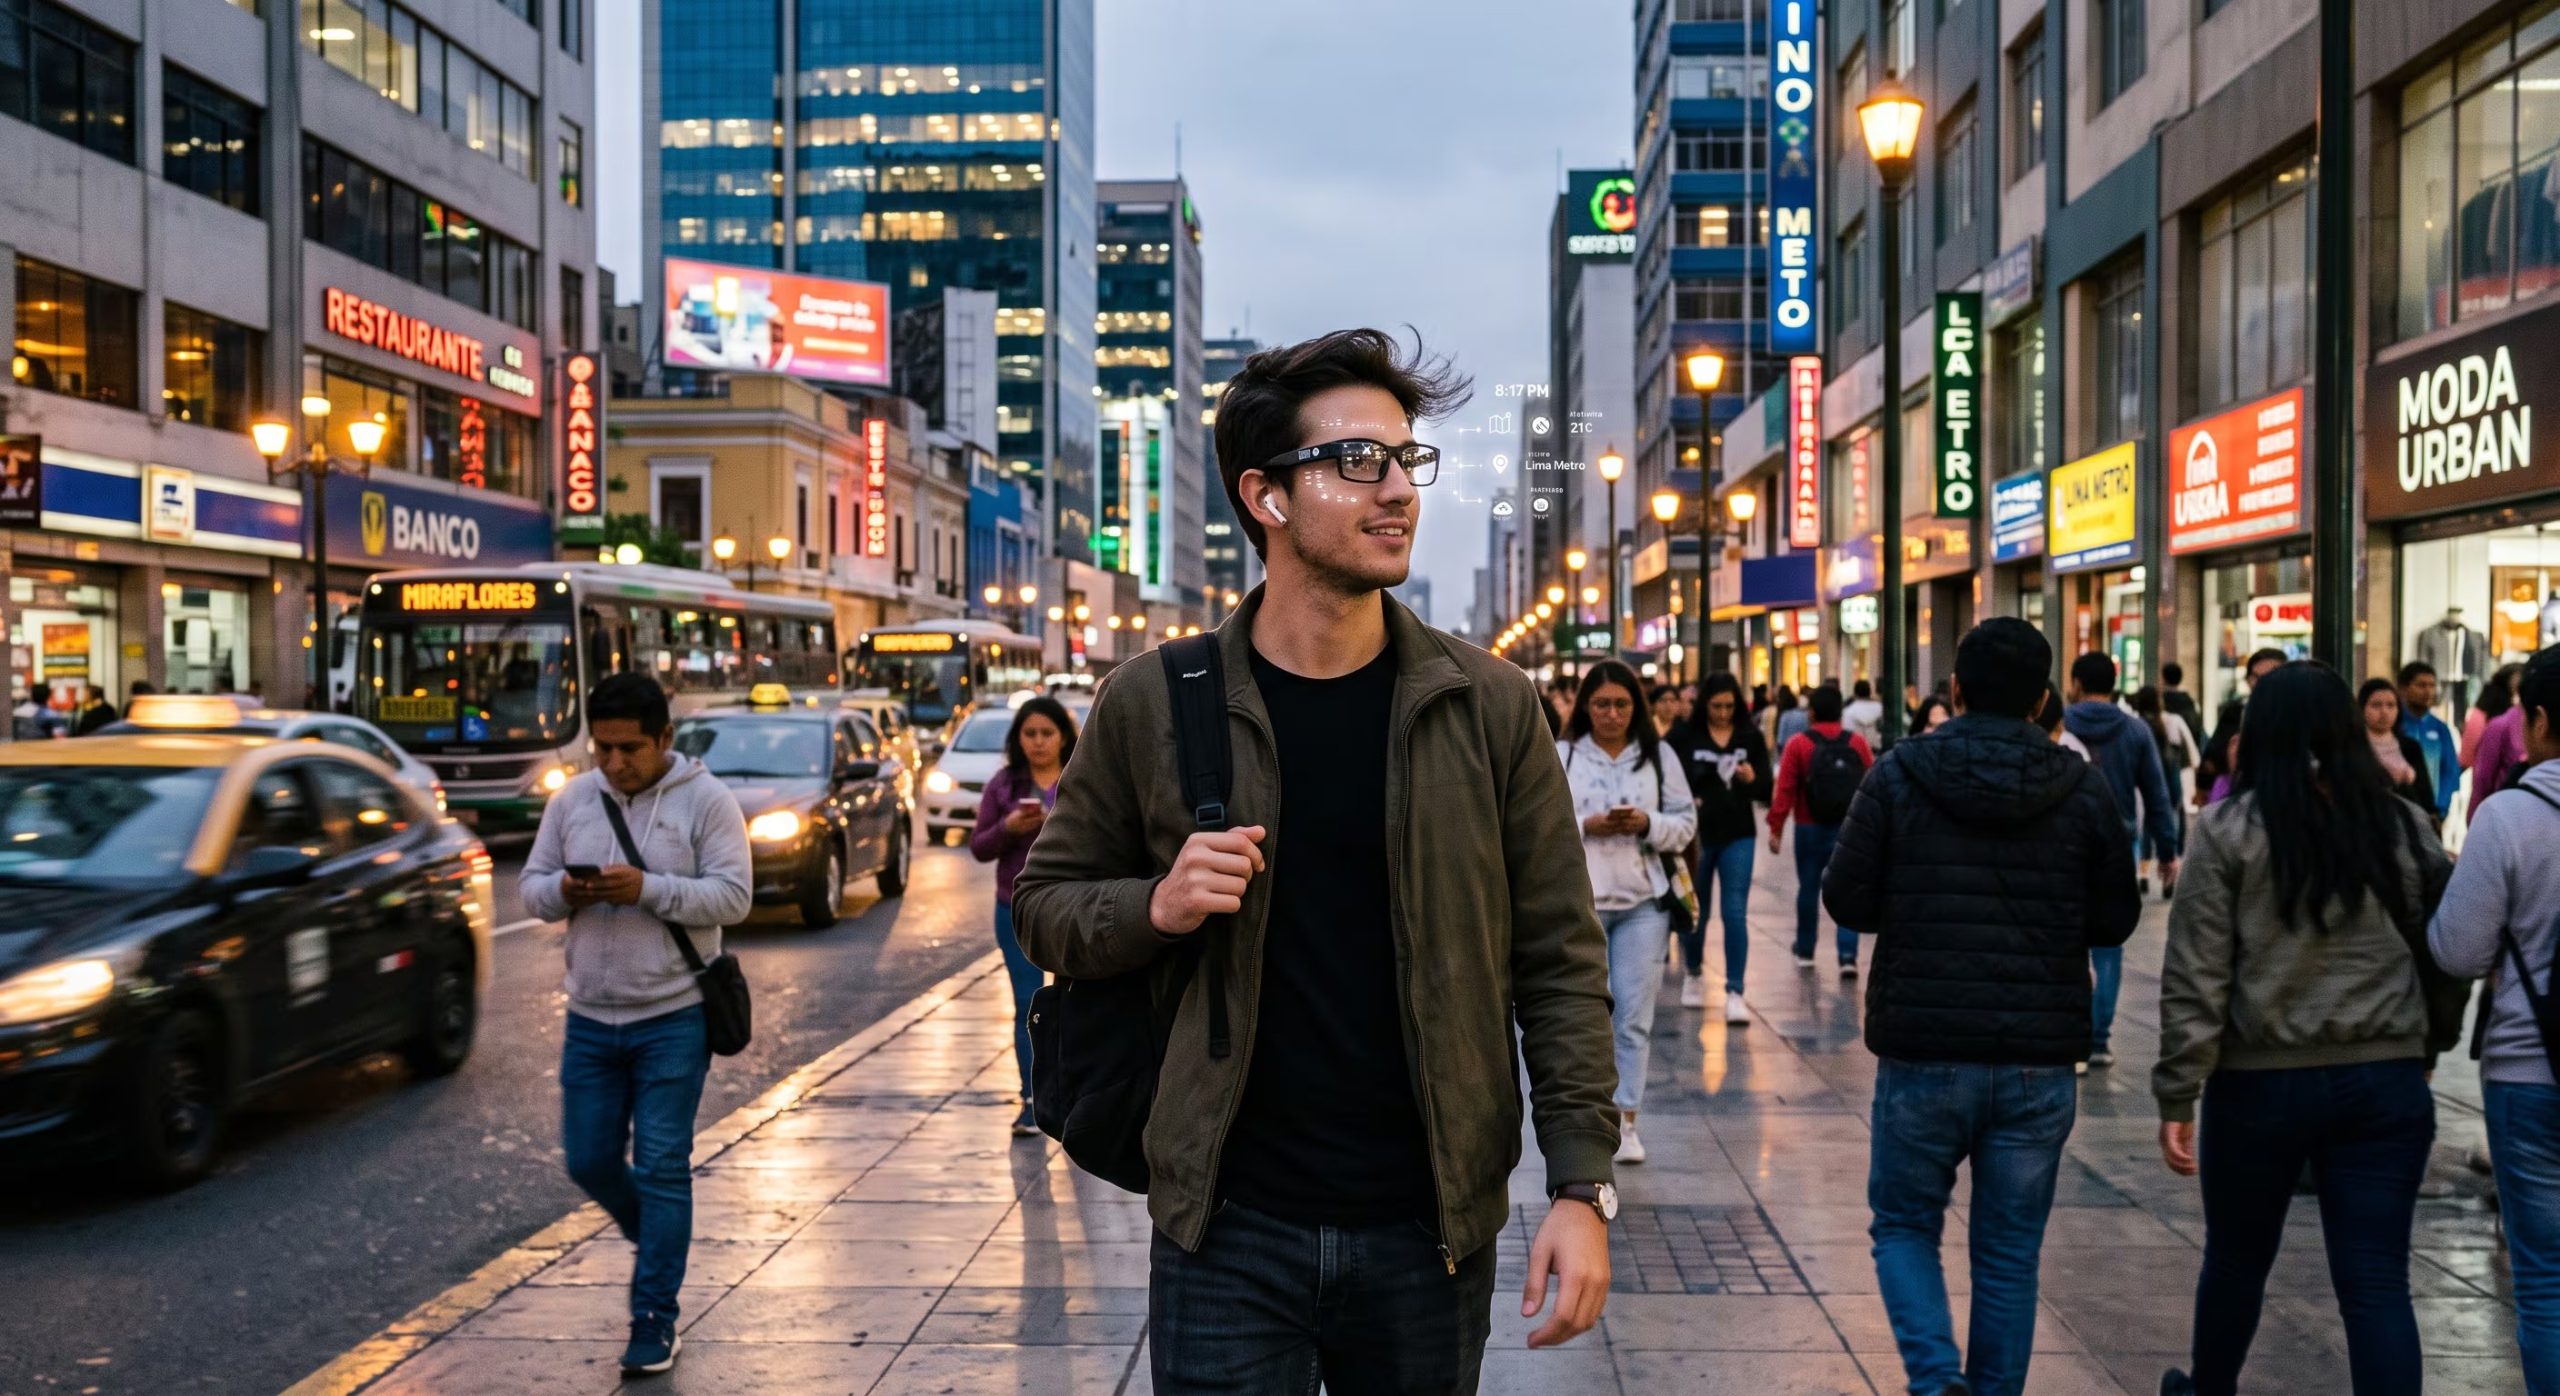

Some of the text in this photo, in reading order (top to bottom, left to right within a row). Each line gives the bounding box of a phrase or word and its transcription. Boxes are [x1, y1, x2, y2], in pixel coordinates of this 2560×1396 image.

[1775, 1, 1813, 113] INO
[1776, 206, 1811, 328] METO
[326, 287, 484, 382] RESTAURANTE
[1942, 301, 1974, 511] LCA ETRO
[2399, 345, 2519, 433] MODA
[2399, 405, 2531, 493] URBAN
[393, 506, 480, 560] BANCO
[402, 582, 537, 611] MIRAFLORES
